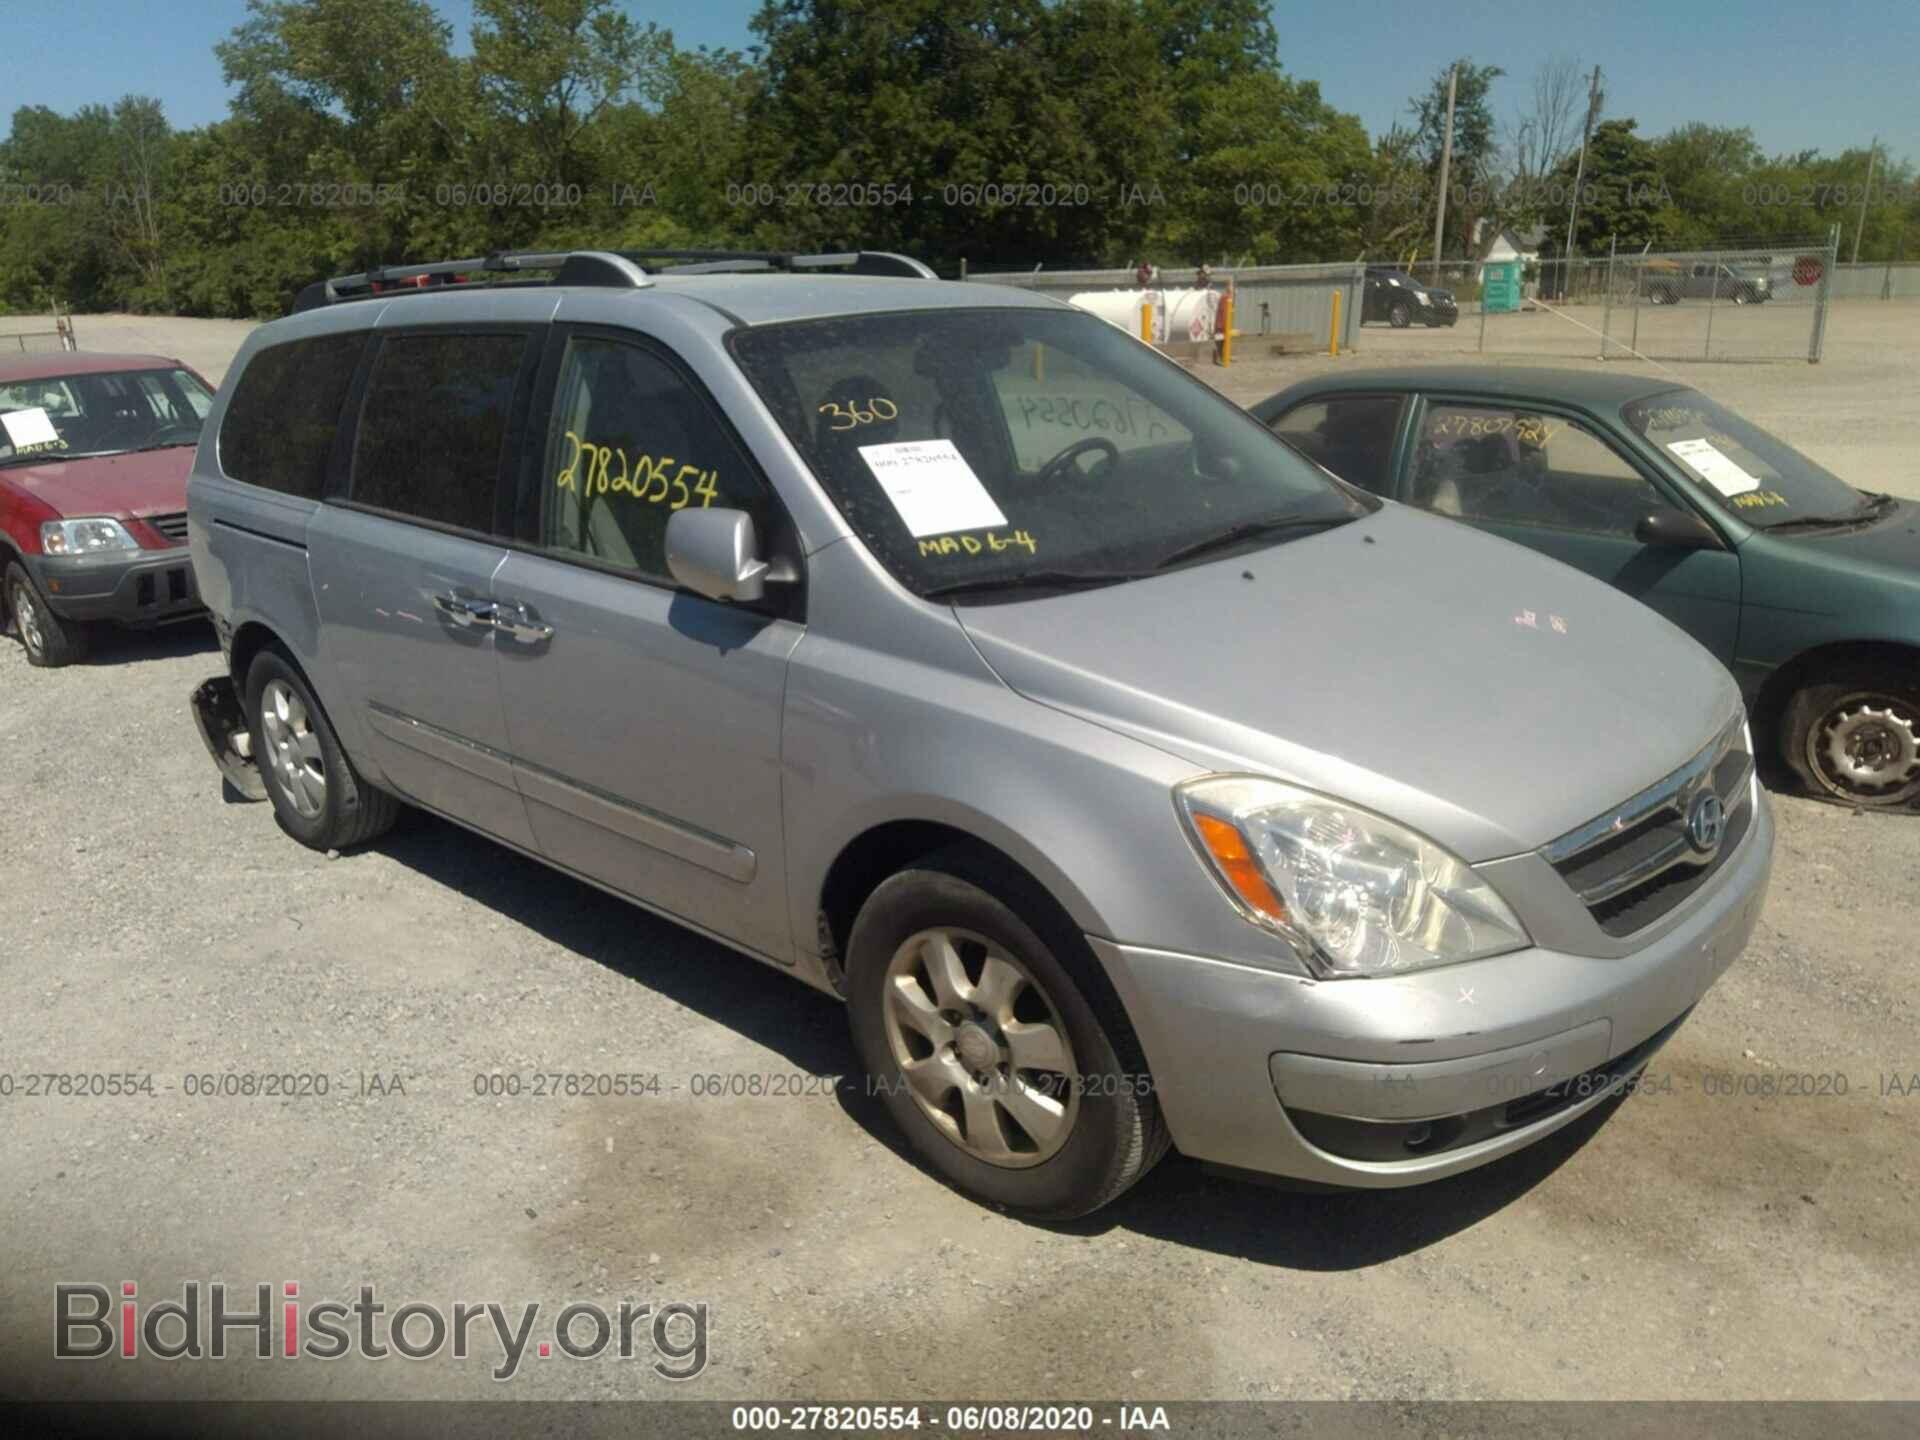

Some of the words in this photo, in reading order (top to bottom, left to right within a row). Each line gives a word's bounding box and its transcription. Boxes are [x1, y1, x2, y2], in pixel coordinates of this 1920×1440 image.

[819, 398, 898, 430] 360
[557, 431, 718, 509] 27820554
[917, 536, 981, 557] MAD
[987, 530, 1037, 554] 6-4
